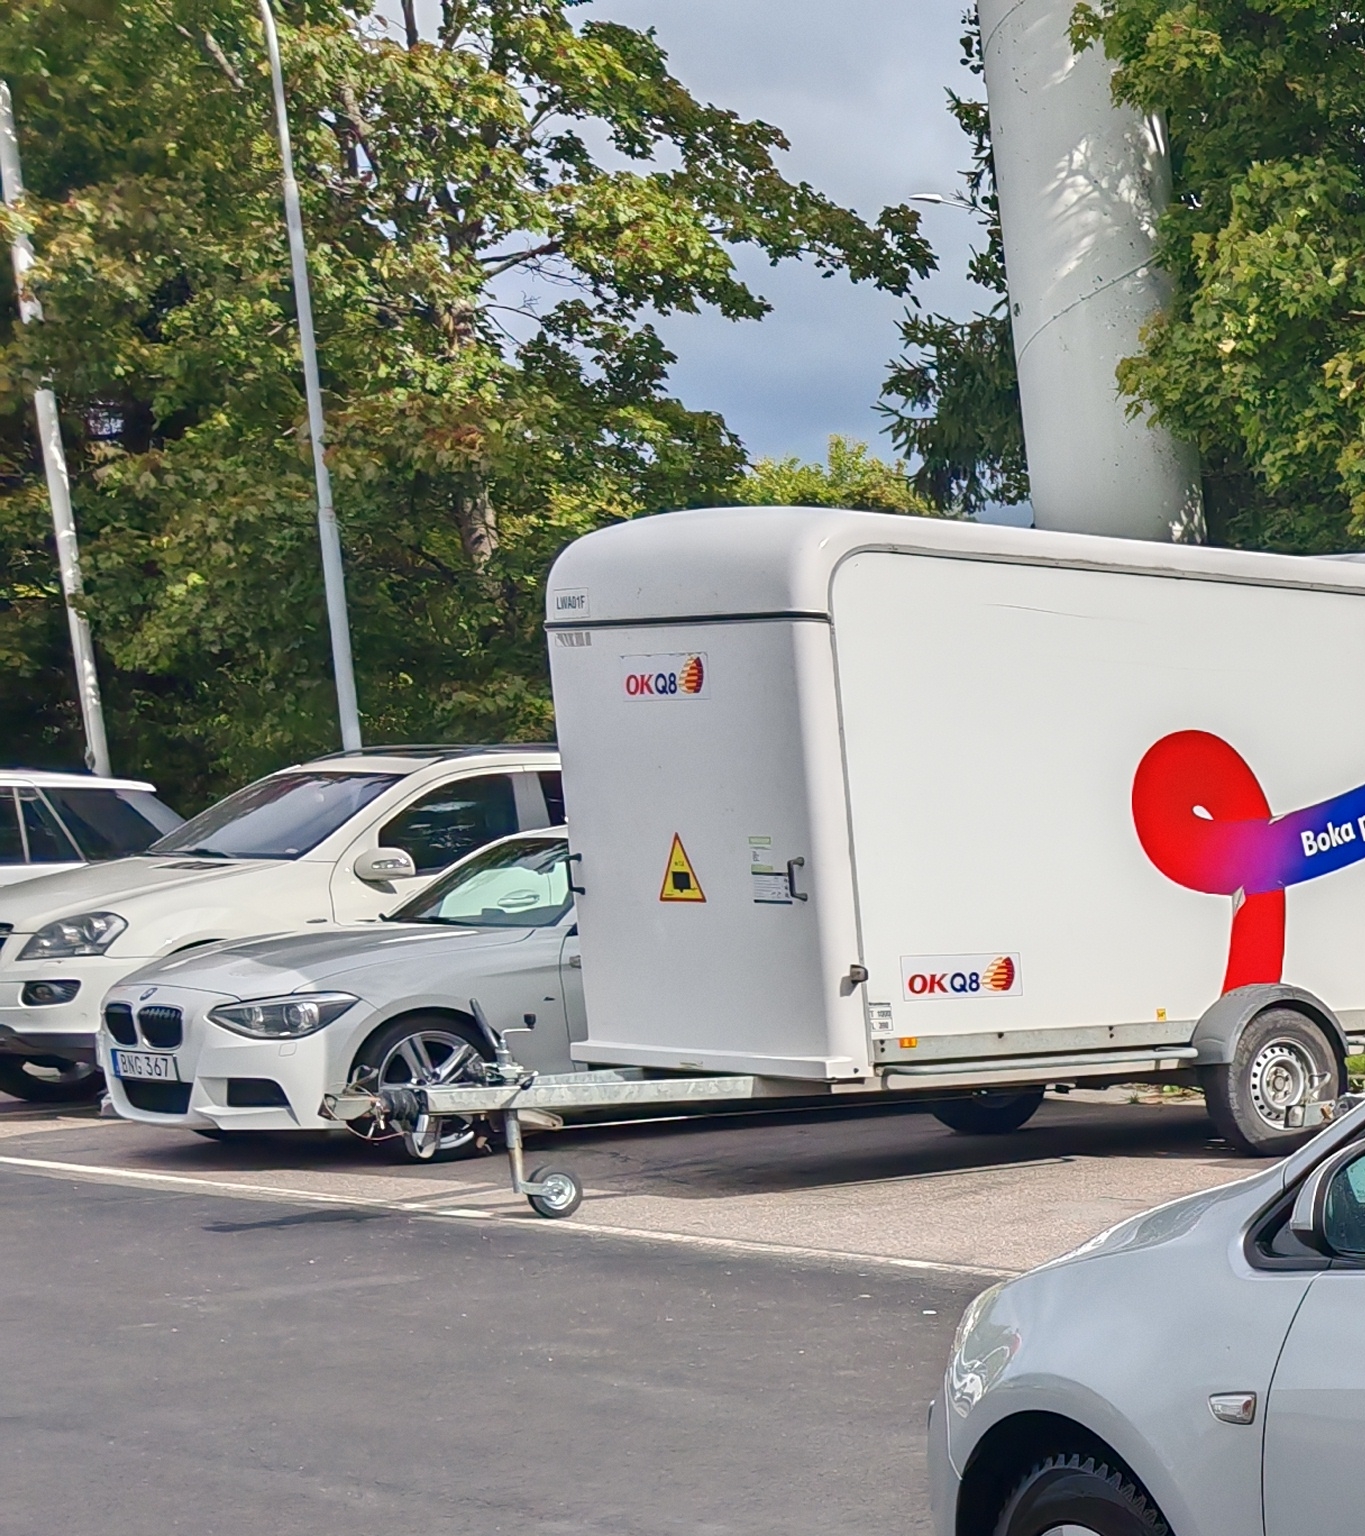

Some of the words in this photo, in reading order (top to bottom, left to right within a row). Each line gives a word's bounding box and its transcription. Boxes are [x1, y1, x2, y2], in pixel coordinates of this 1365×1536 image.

[626, 672, 677, 695] OKQ8
[1300, 822, 1356, 857] Boka
[908, 972, 981, 994] OKQ8
[120, 1053, 143, 1075] BNG
[144, 1056, 168, 1077] 367
